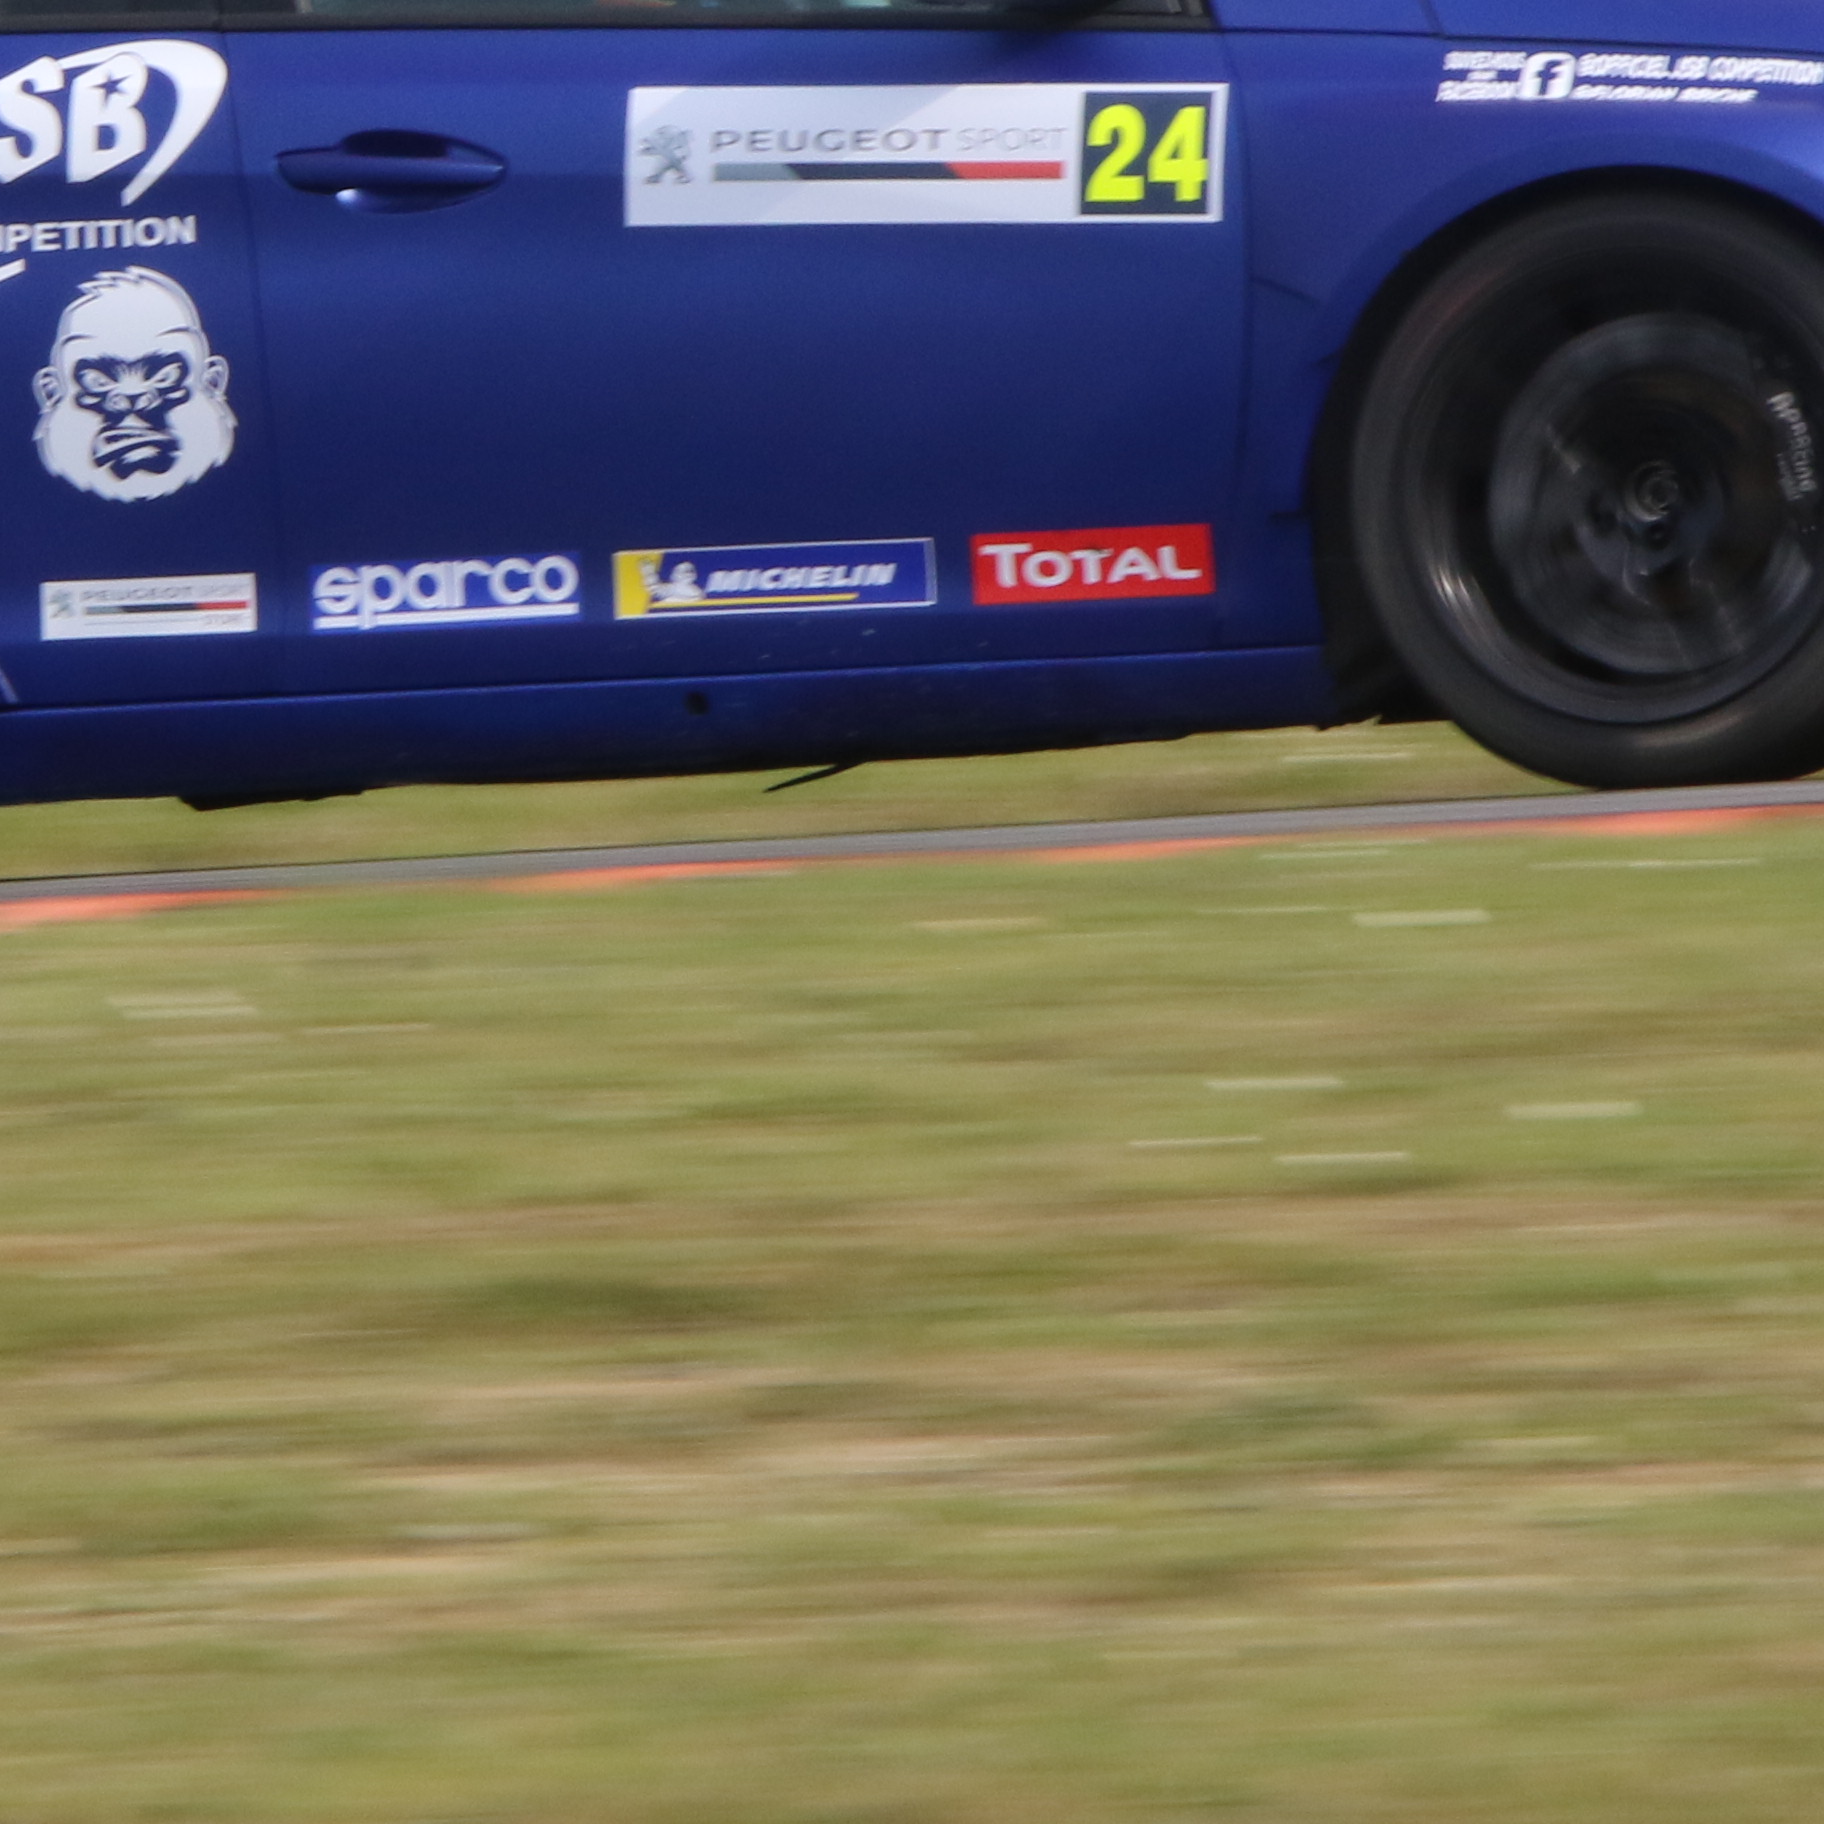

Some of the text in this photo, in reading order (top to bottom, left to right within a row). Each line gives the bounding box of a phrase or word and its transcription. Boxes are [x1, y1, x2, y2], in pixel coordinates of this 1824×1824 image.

[708, 125, 1068, 155] PEUGEOT SPORT
[1084, 102, 1210, 204] 24
[704, 562, 898, 594] MICHELIN
[978, 542, 1204, 589] TOTAL
[313, 554, 580, 629] sparco
